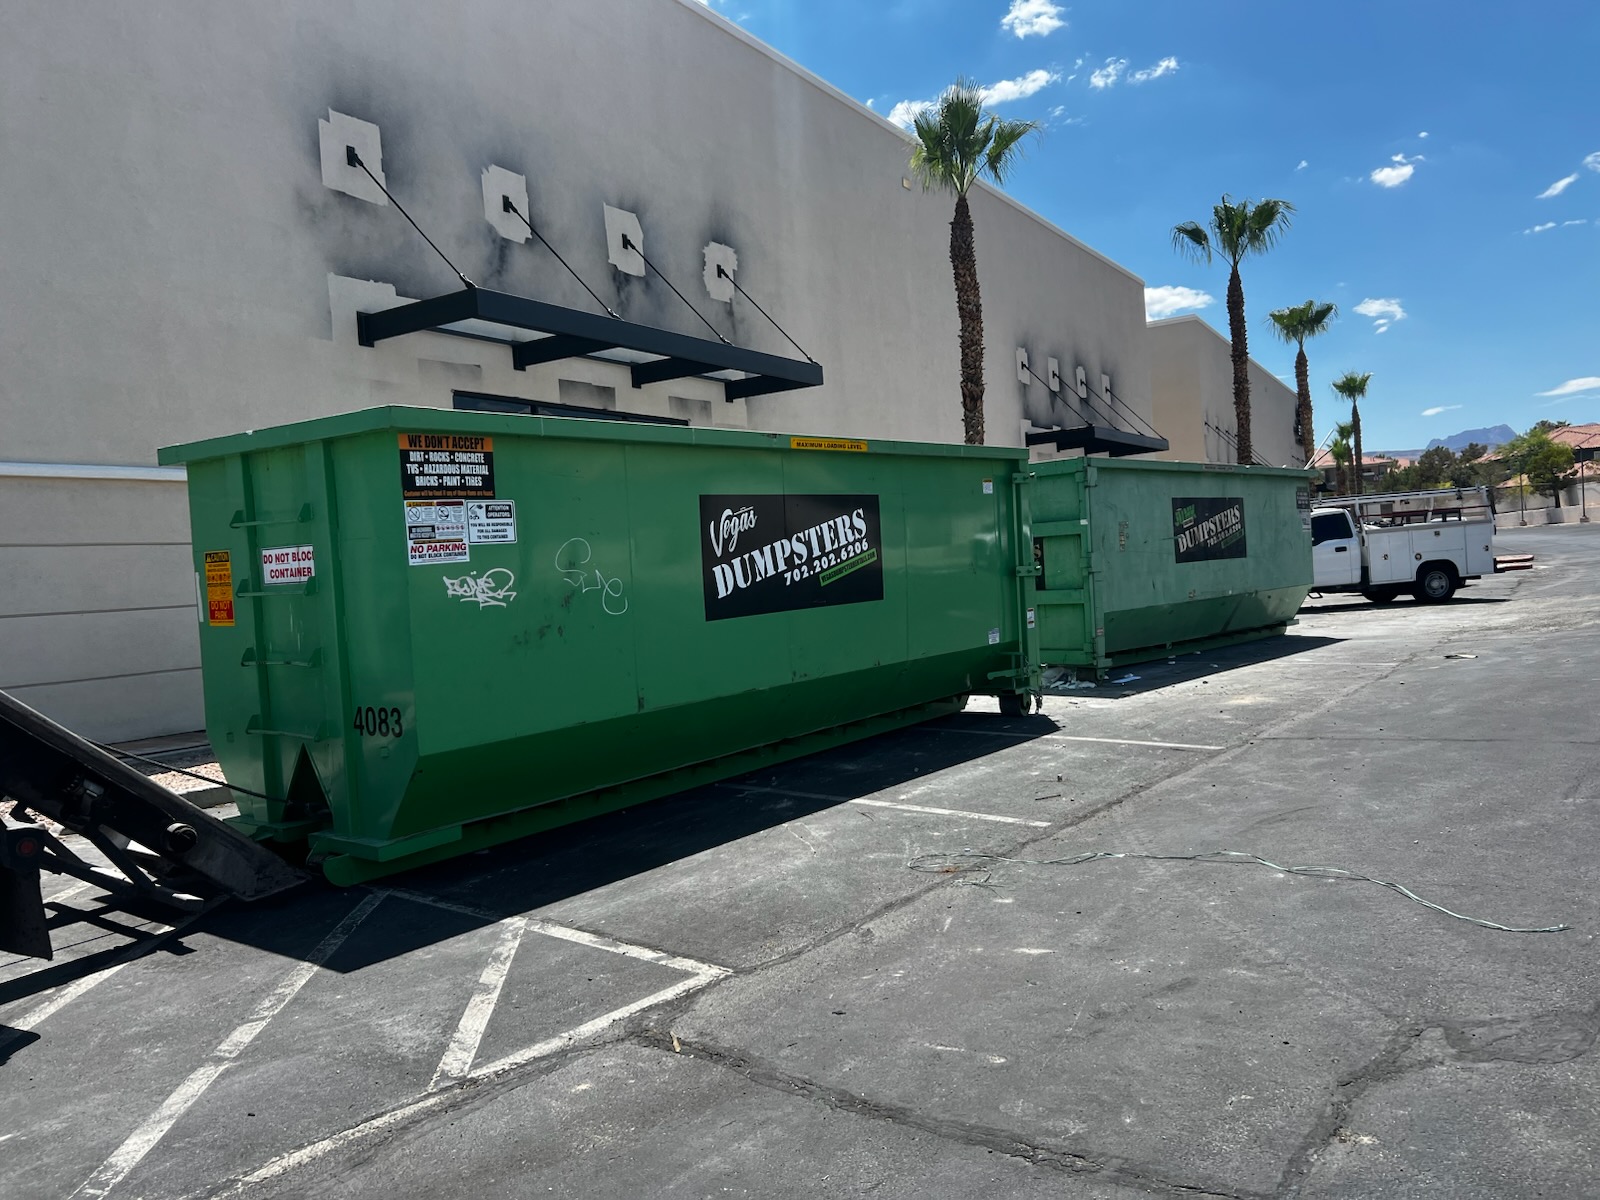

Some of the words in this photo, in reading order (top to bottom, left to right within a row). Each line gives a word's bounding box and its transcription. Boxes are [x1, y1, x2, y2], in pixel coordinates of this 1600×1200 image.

[408, 435, 422, 448] WE
[424, 435, 449, 449] DON'T
[452, 437, 484, 450] ACCEPT
[409, 451, 424, 462] DIRT
[429, 452, 450, 462] ROCKS
[454, 452, 484, 463] CONCRETE
[423, 464, 460, 474] HAZARDOUS
[460, 464, 489, 475] MATERIAL
[415, 476, 438, 486] BRICKS
[443, 476, 460, 486] PAINT
[465, 476, 482, 486] TIRES
[710, 506, 758, 557] Vegas
[1178, 505, 1240, 553] DUMPSTERS
[411, 545, 424, 553] NO
[427, 543, 466, 552] PARKING
[712, 508, 867, 599] DUMPSTERS
[263, 554, 273, 564] DO
[275, 553, 290, 563] NOT
[784, 538, 869, 586] 702.202.6206
[270, 567, 312, 579] CONTAINER
[211, 602, 219, 610] DO
[220, 601, 230, 609] NOT
[215, 611, 228, 619] PARK
[353, 706, 403, 738] 4083
